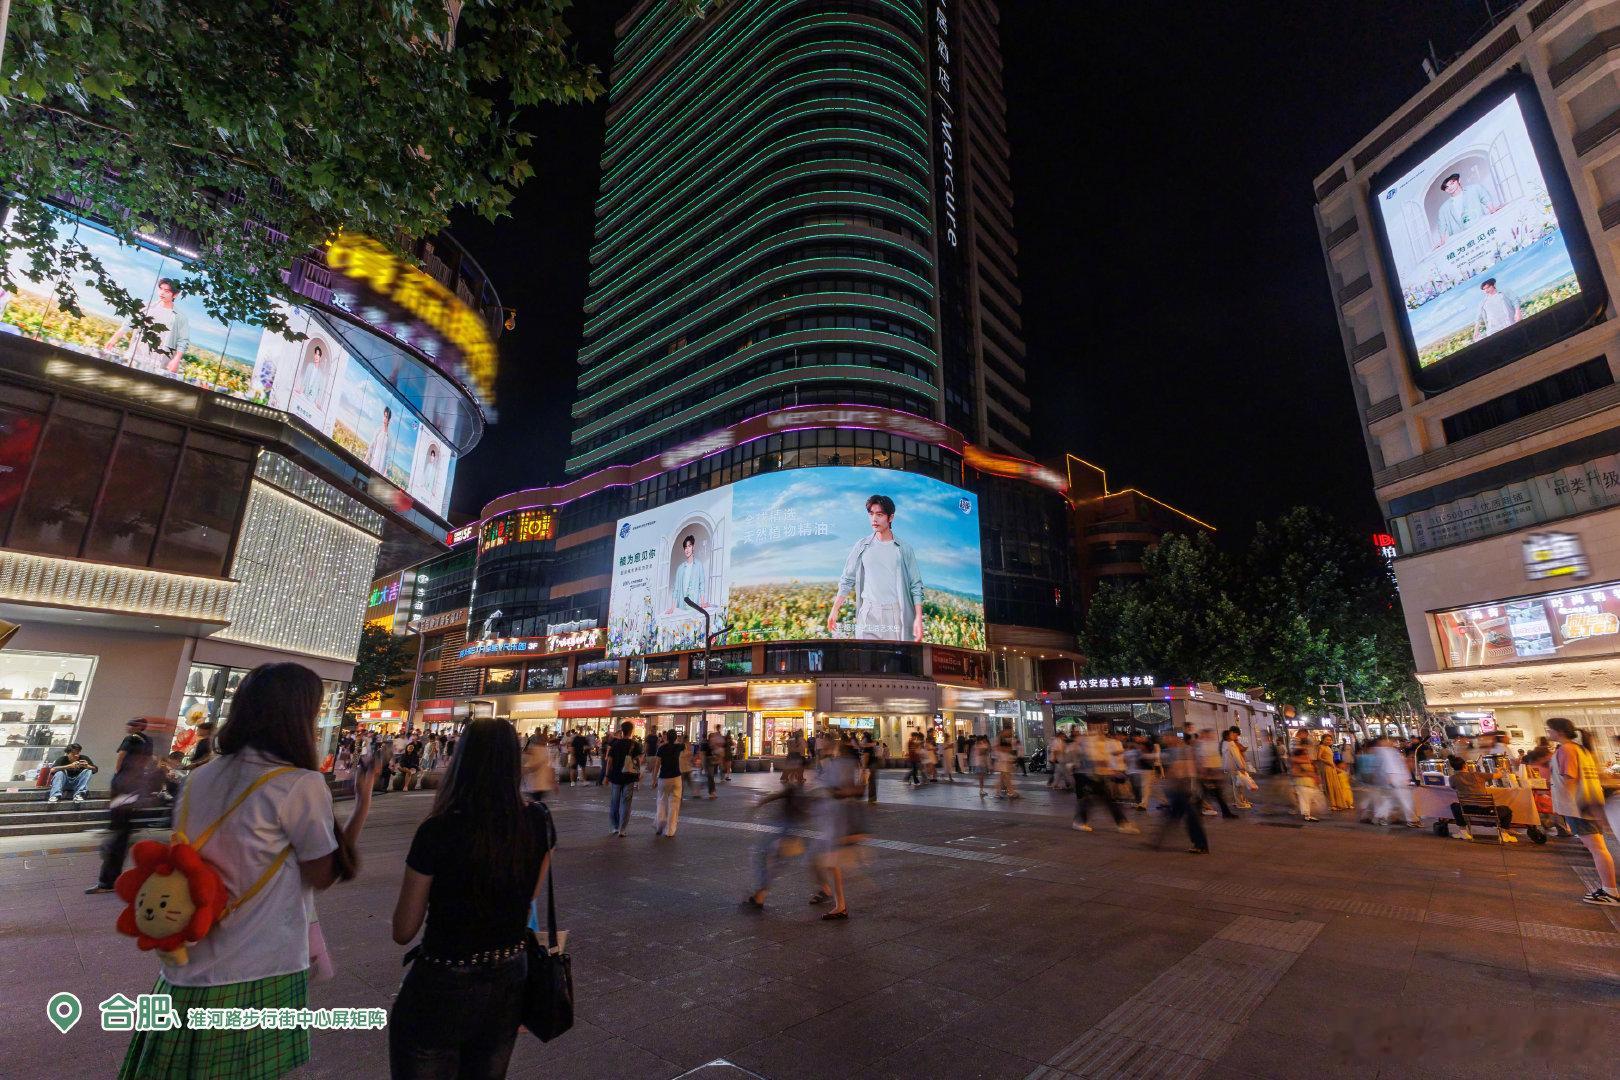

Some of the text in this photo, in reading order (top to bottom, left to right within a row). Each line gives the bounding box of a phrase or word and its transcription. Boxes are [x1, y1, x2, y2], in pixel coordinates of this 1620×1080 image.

[941, 113, 957, 248] Mercure
[1058, 675, 1154, 690] 合肥公安综合警务站
